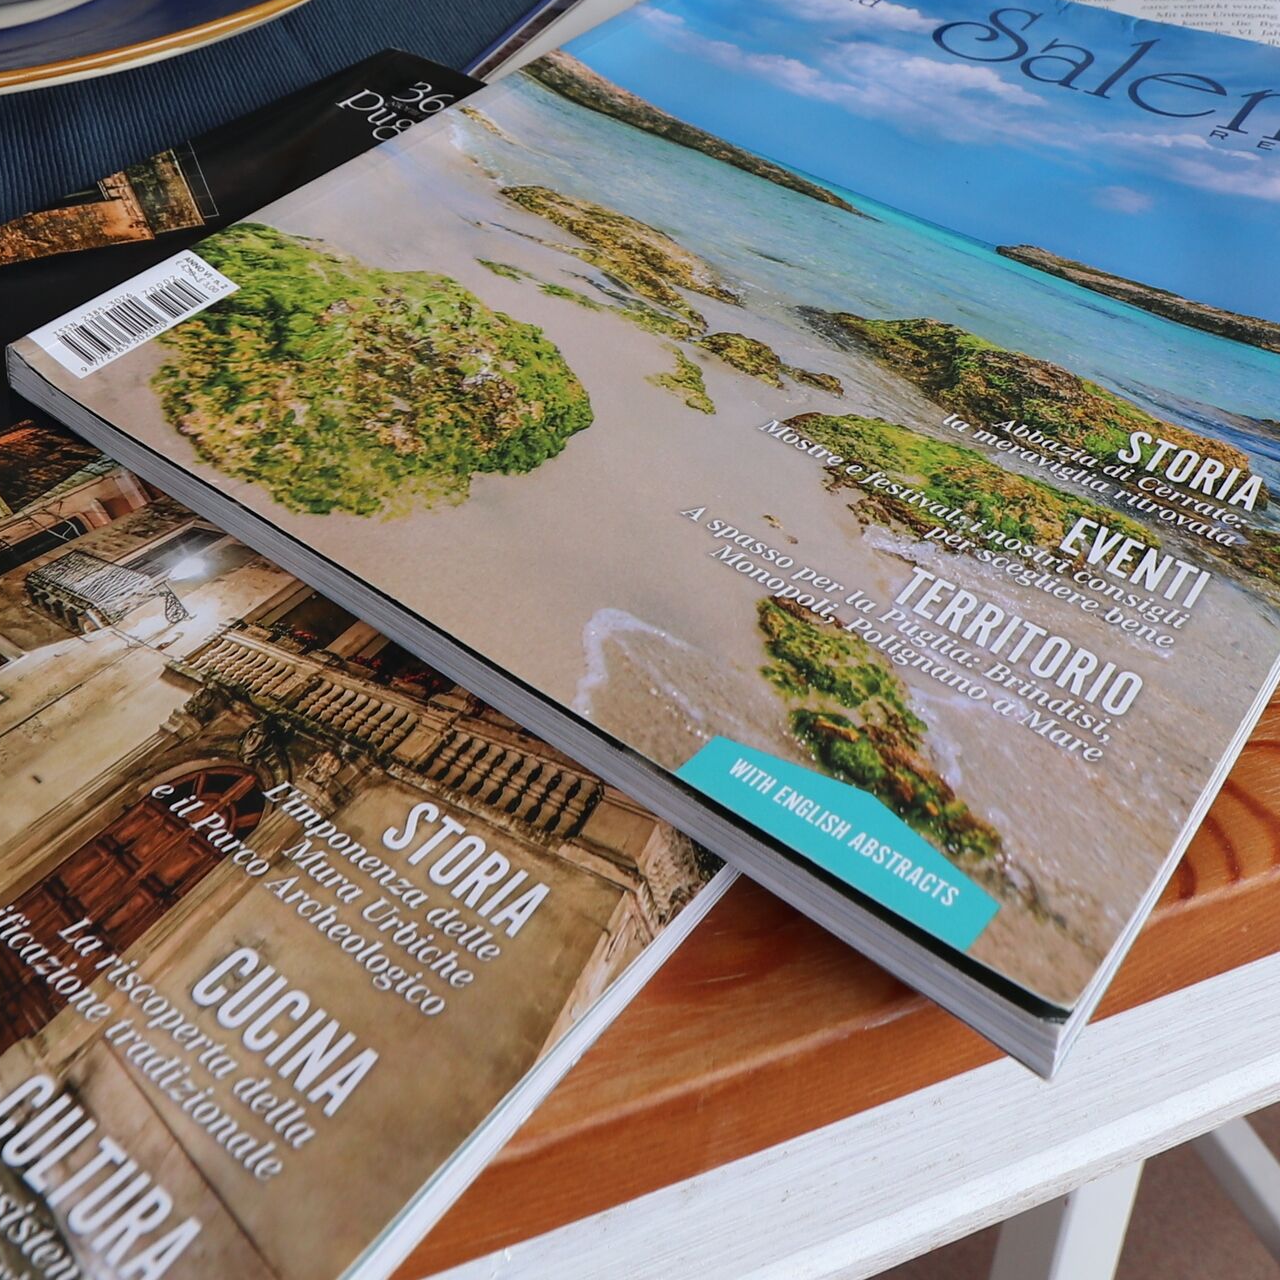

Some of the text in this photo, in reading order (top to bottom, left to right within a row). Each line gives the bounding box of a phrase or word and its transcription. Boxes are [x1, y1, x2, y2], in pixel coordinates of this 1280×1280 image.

[53, 322, 78, 338] ISSN
[759, 420, 844, 466] Mostre
[845, 463, 863, 476] e
[969, 519, 987, 534] i
[985, 527, 1073, 573] nostri
[1072, 570, 1192, 629] consigli
[942, 413, 1235, 548] la meraviglia ritrovata
[992, 420, 1248, 529] Abbazia di Cerrate:
[1117, 431, 1264, 512] STORIA
[680, 506, 1111, 744] A spasso per la Puglia: Brindisi,
[924, 526, 1175, 648] per scegliere bene
[1059, 516, 1211, 609] EVENTI
[710, 544, 1104, 762] Monopoli, Polignano a Mare
[895, 566, 1144, 716] TERRITORIO
[150, 783, 448, 1016] e il Parco Archeologico
[262, 780, 502, 962] L'imponenza delle
[381, 801, 551, 939] STORIA
[729, 758, 960, 907] WITH ENGLISH ABSTRACTS
[282, 838, 475, 989] Mura Urbiche
[57, 916, 317, 1150] La riscoperta della
[104, 1018, 285, 1181] tradizionale
[191, 947, 379, 1118] CUCINA
